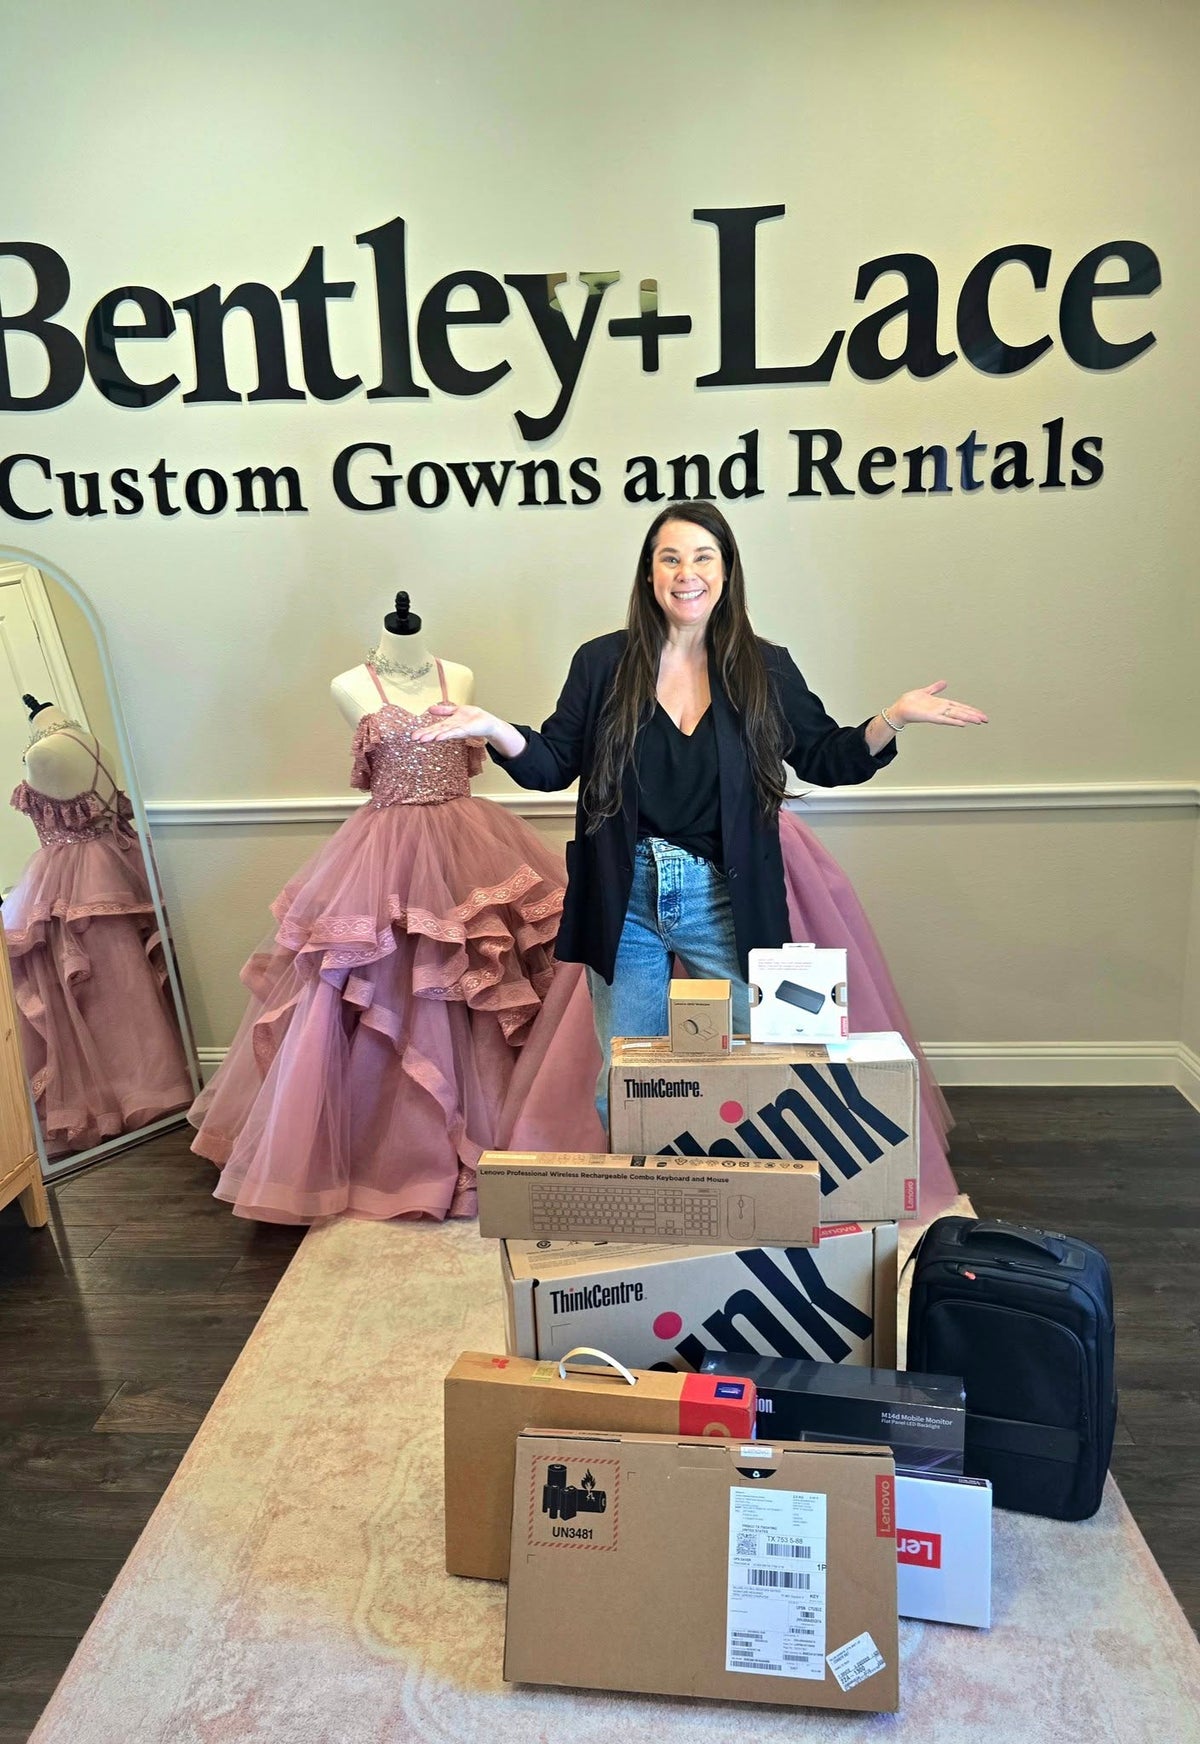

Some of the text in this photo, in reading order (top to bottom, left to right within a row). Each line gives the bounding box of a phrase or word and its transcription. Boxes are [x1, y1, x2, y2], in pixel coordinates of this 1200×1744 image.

[0, 417, 1105, 520] Custom Gowns and Rentals
[581, 1172, 628, 1180] Rechargeable
[656, 1175, 690, 1183] Keyboard
[906, 1181, 914, 1209] Lenovo
[881, 1412, 953, 1426] M14d Mobile Monitor
[880, 1480, 891, 1532] Lenovo
[552, 1526, 593, 1540] UN3481
